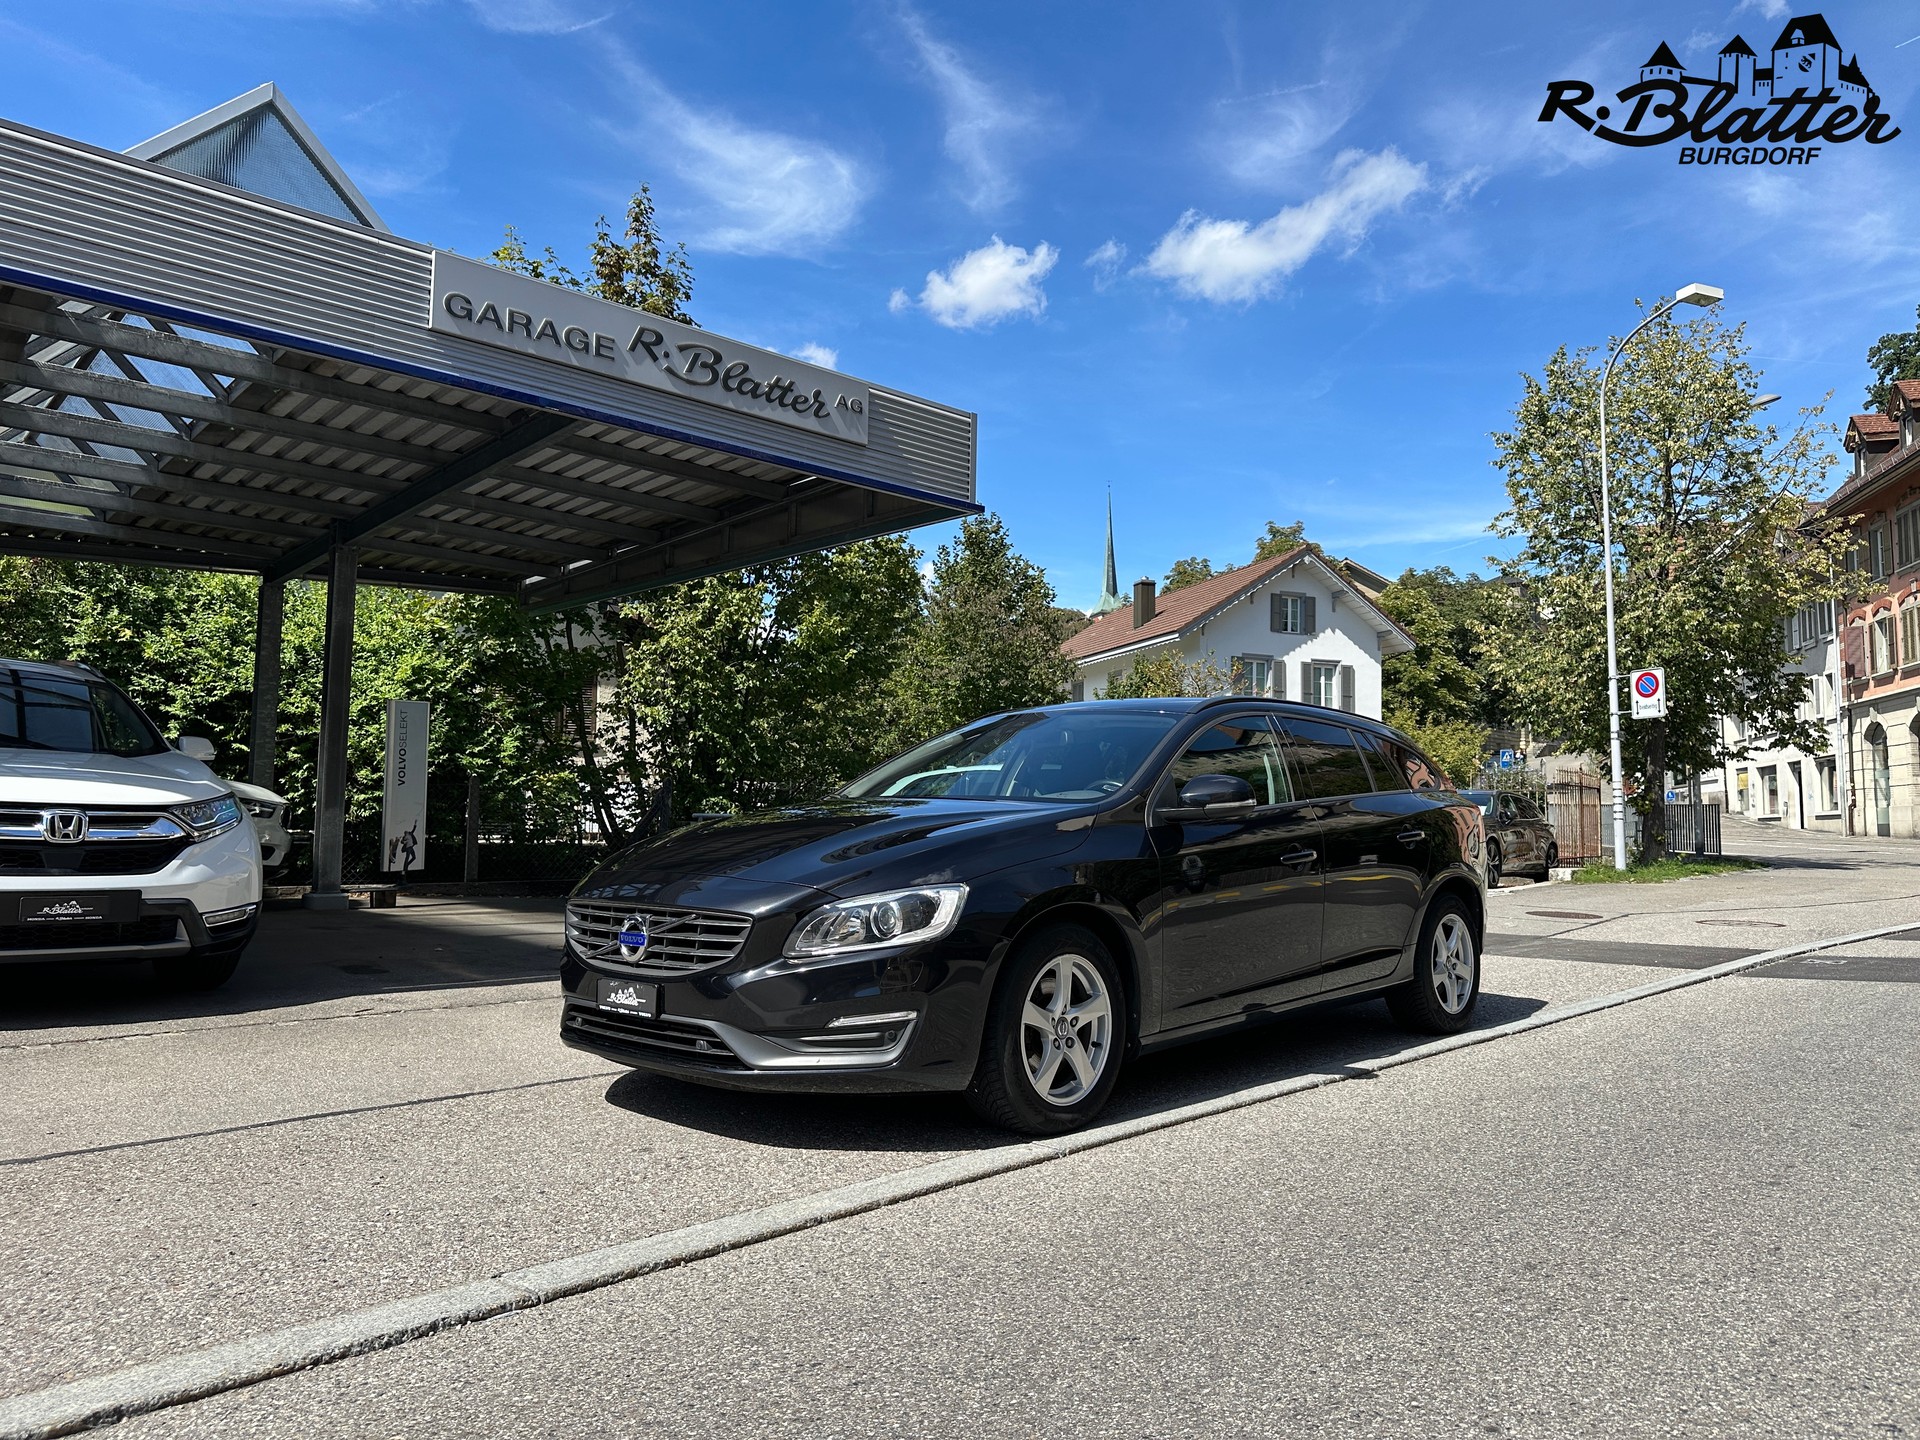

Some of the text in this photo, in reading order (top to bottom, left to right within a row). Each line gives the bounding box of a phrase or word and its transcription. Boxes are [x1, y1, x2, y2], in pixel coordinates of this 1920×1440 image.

[442, 291, 616, 361] GARAGE
[834, 393, 864, 415] AG
[620, 934, 644, 944] VOLVO
